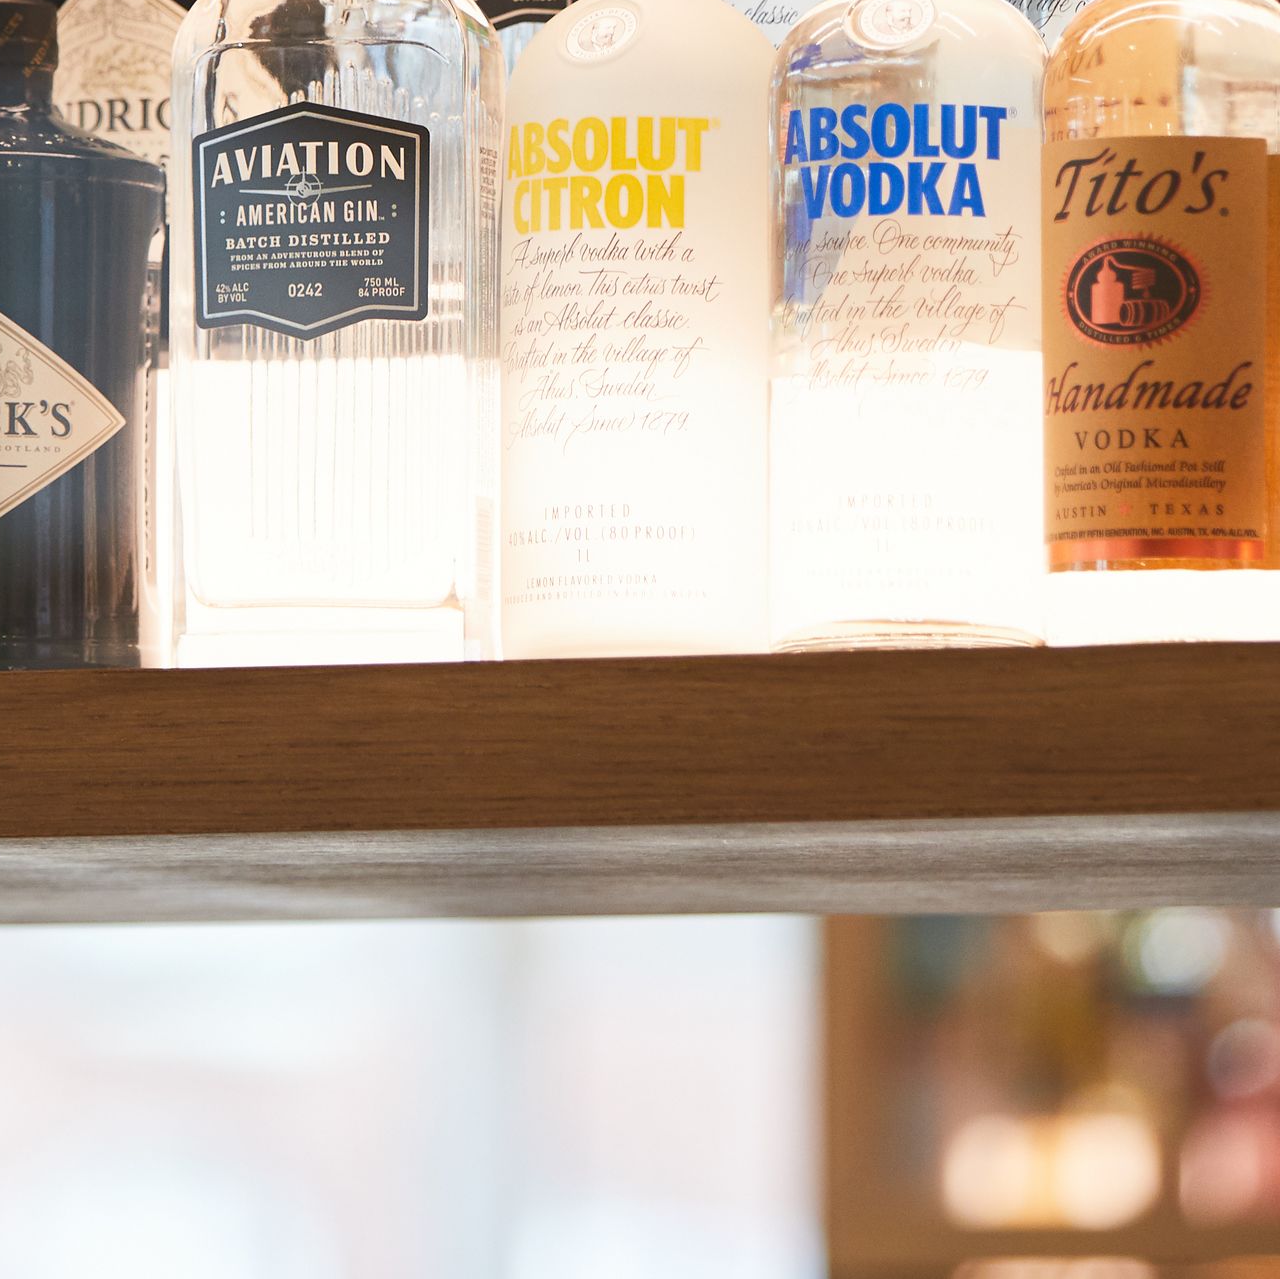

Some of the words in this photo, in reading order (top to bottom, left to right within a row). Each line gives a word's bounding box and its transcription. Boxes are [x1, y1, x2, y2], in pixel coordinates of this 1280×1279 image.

[784, 103, 1008, 165] ABSOLUT
[507, 116, 710, 180] ABSOLUT
[211, 141, 405, 188] AVIATION
[799, 161, 987, 220] VODKA
[1053, 146, 1229, 224] Tito's
[236, 201, 335, 227] AMERICAN
[343, 200, 379, 222] GIN
[513, 173, 686, 235] CITRON
[225, 235, 281, 250] BATCH
[288, 232, 391, 248] DISTILLED
[580, 232, 629, 262] vodka
[633, 231, 683, 262] with
[681, 248, 696, 262] a
[872, 218, 920, 256] One
[230, 254, 254, 262] FROM
[256, 253, 268, 261] AN
[271, 251, 337, 260] ADVENTUROUS
[340, 250, 370, 258] BLEND
[231, 263, 261, 271] SPICES
[263, 261, 287, 270] FROM
[290, 260, 327, 269] AROUND
[350, 258, 384, 267] WORLD
[1081, 240, 1118, 265] AWARD
[1123, 239, 1179, 262] WINNING
[232, 282, 249, 292] ALC
[363, 277, 382, 287] 750
[384, 277, 400, 287] ML
[582, 268, 622, 297] This
[622, 272, 668, 296] citrus
[671, 274, 724, 302] twist
[799, 257, 848, 290] One
[851, 253, 922, 295] superb
[218, 293, 229, 303] BY
[230, 293, 247, 302] VOL
[288, 283, 323, 298] 0242
[358, 287, 370, 297] 84
[372, 287, 406, 297] PROOF
[542, 300, 619, 337] Absolut
[848, 298, 867, 320] in
[866, 284, 910, 320] the
[912, 284, 988, 338] village
[989, 295, 1028, 345] of
[1078, 320, 1130, 344] DISTILLED
[570, 332, 598, 365] the
[603, 334, 669, 380] village
[670, 336, 712, 380] of
[1044, 360, 1253, 418] Handmade
[1075, 428, 1191, 451] VODKA
[1103, 462, 1120, 474] Old
[1125, 460, 1176, 473] Fashioned
[1180, 460, 1197, 472] Pot
[1203, 459, 1226, 473] Still
[1101, 478, 1142, 494] Original
[1146, 476, 1226, 494] Microdistillery
[1055, 505, 1107, 521] AUSTIN
[1149, 503, 1226, 516] TEXAS
